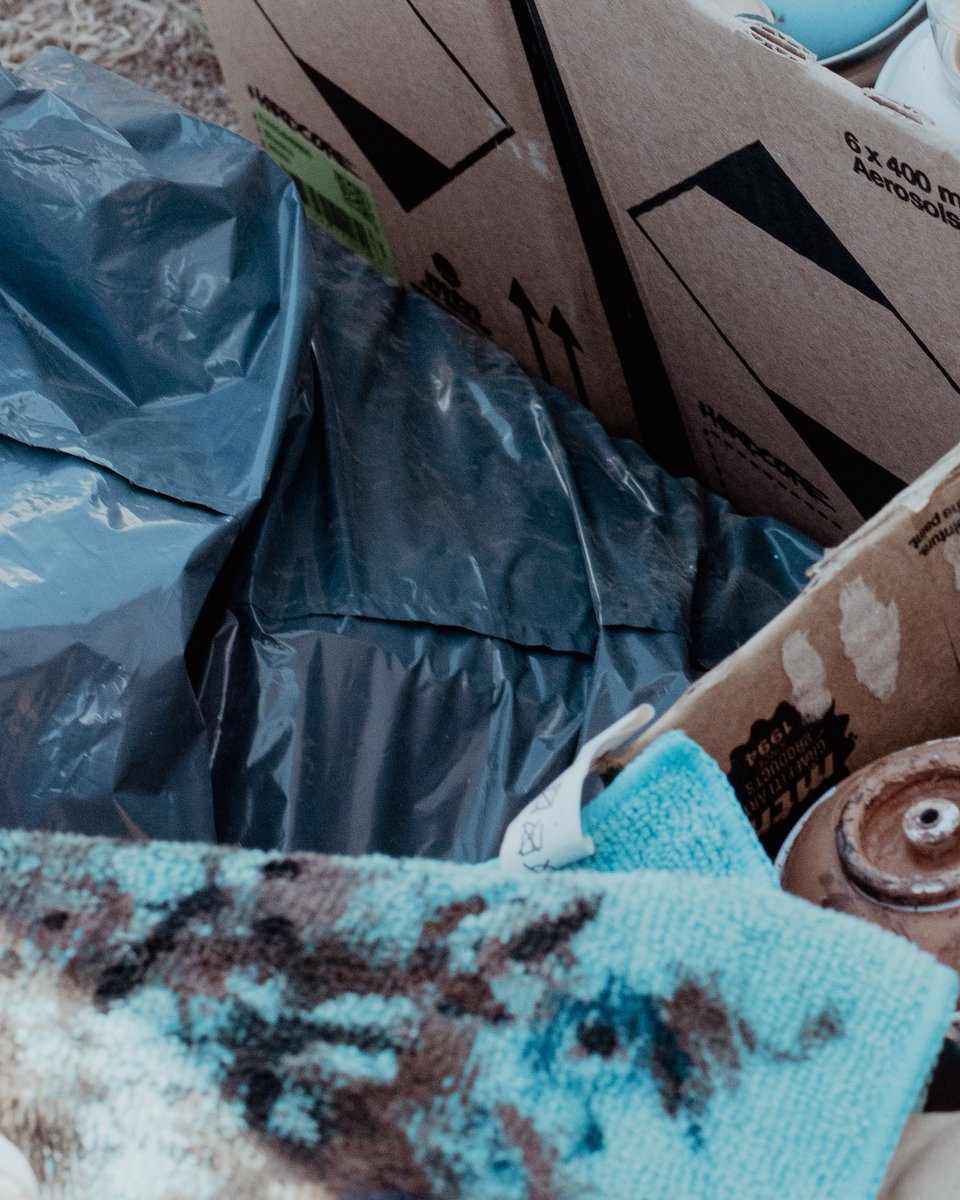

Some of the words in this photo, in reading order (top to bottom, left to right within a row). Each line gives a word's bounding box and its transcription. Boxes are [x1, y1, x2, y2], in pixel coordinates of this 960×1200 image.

[844, 131, 861, 157] 6
[866, 145, 882, 168] x
[886, 156, 932, 195] 400
[908, 513, 942, 548] paint.
[744, 721, 792, 766] 1994
[745, 733, 812, 795] PRODUCTS
